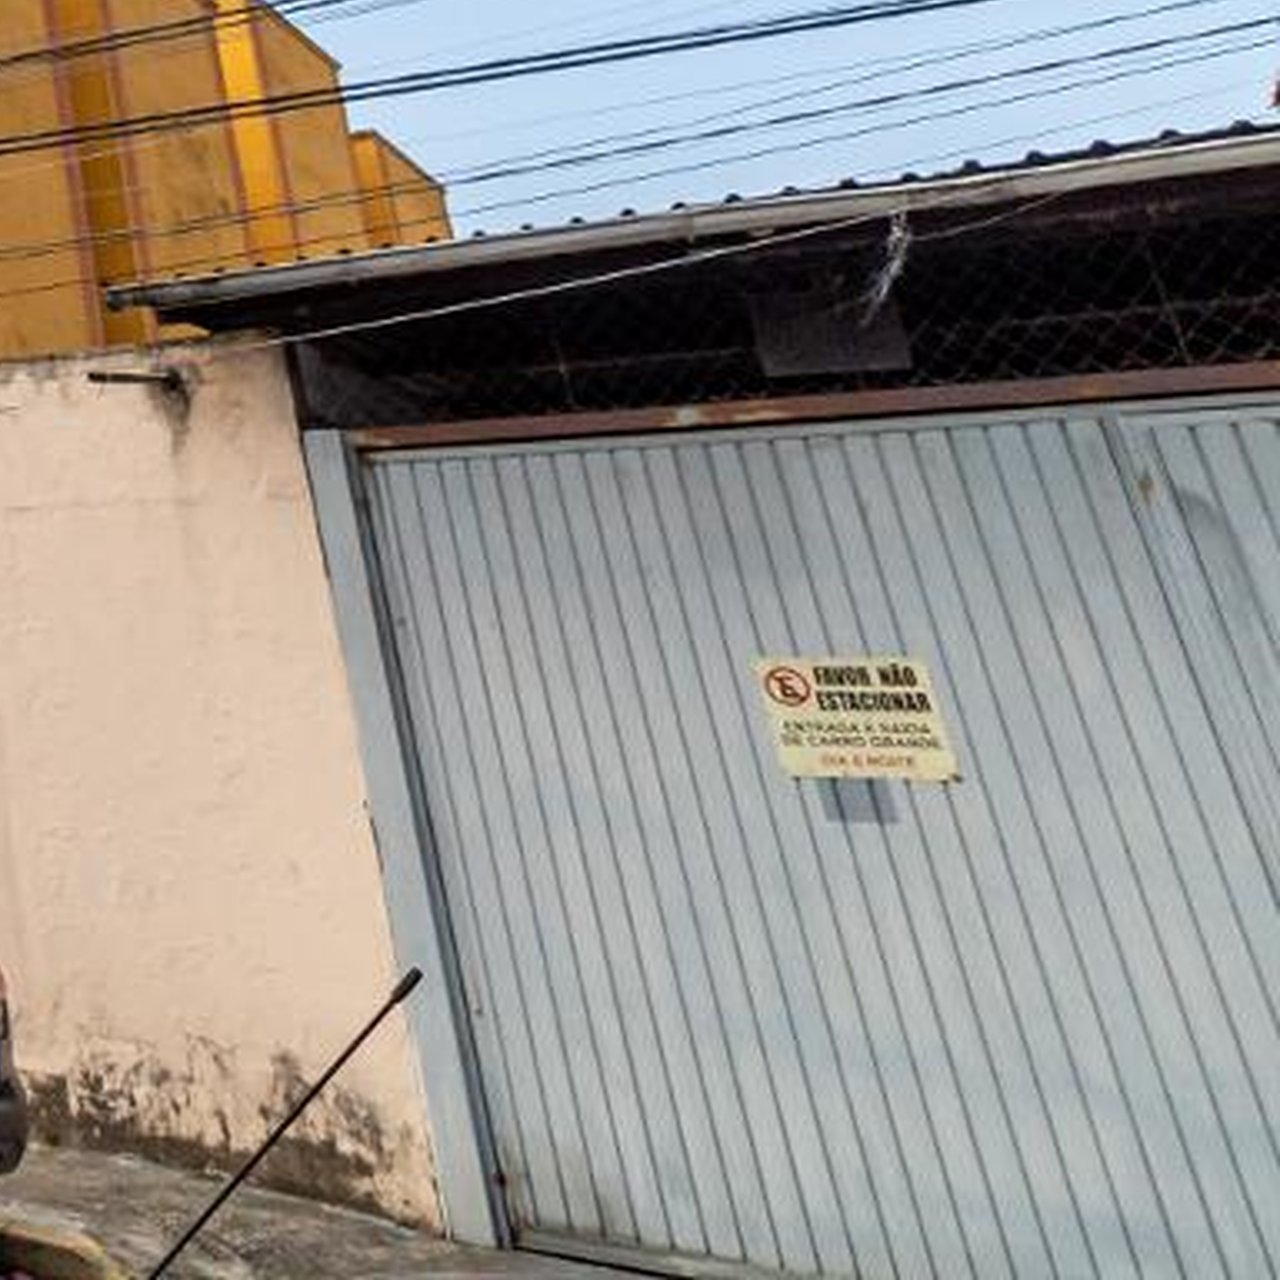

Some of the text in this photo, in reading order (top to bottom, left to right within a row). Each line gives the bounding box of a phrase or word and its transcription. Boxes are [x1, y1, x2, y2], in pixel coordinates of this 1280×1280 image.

[813, 663, 917, 687] FAVOR NÃO
[816, 691, 932, 712] ESTACIONAR
